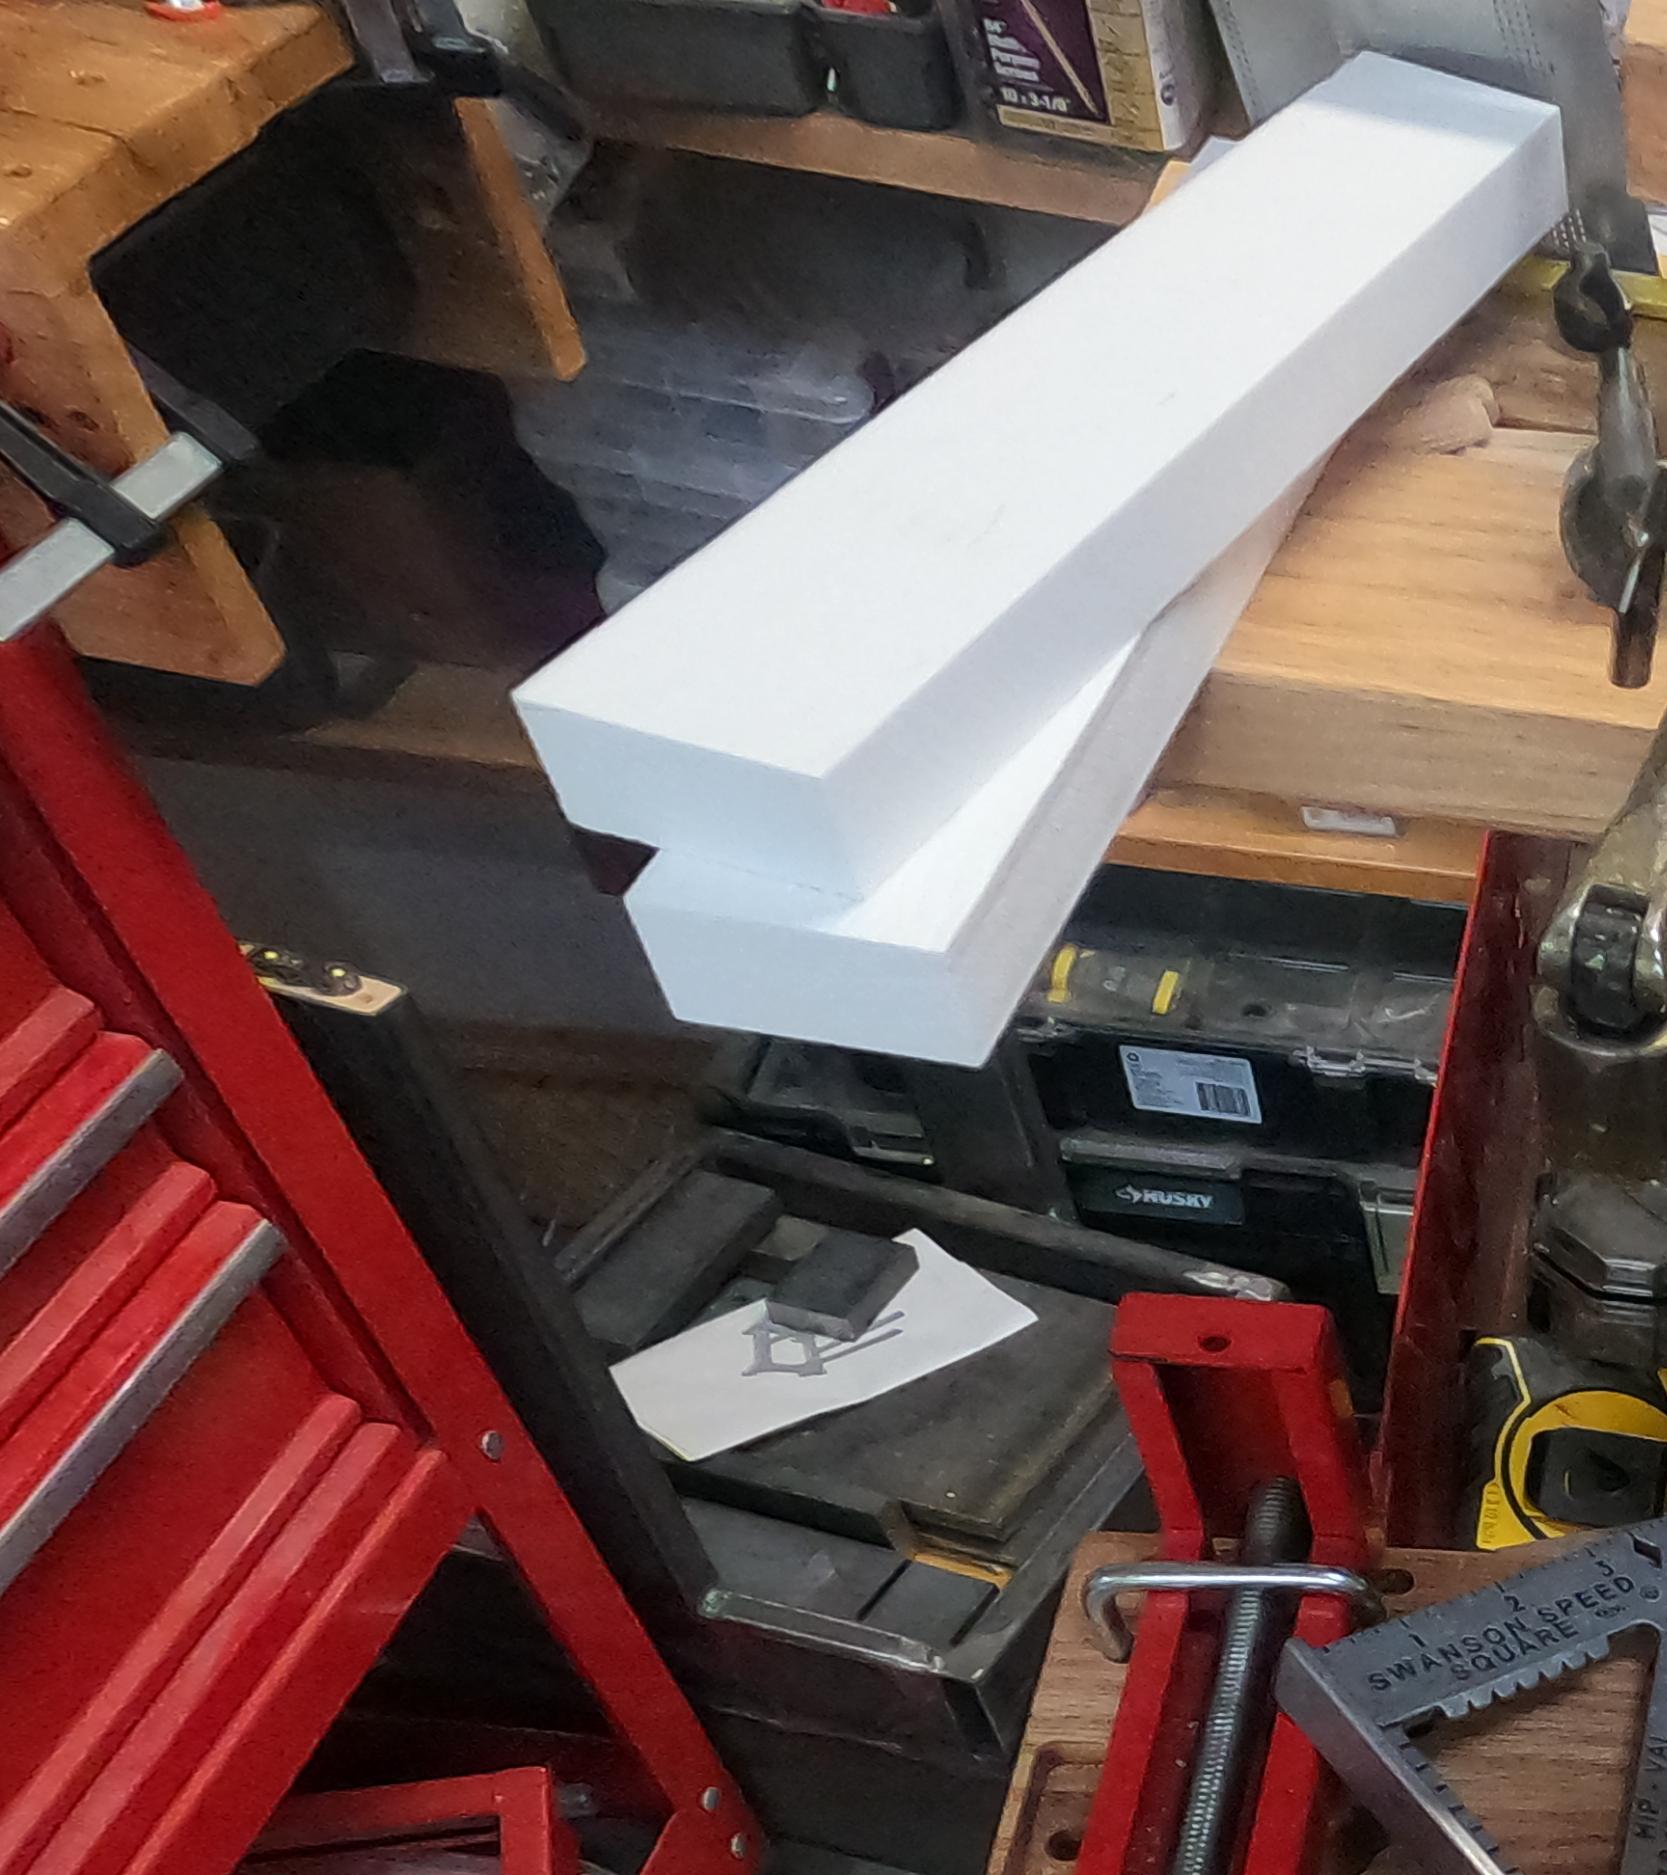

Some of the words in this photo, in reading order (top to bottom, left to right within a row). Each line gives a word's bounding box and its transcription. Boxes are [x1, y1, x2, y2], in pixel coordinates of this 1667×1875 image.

[1142, 1187, 1214, 1210] HUSKY
[1368, 1616, 1530, 1692] SWANSON
[1536, 1576, 1636, 1625] SPEED
[1409, 1632, 1425, 1648] 1
[1504, 1595, 1528, 1613] 2
[1448, 1618, 1579, 1681] SQUARE
